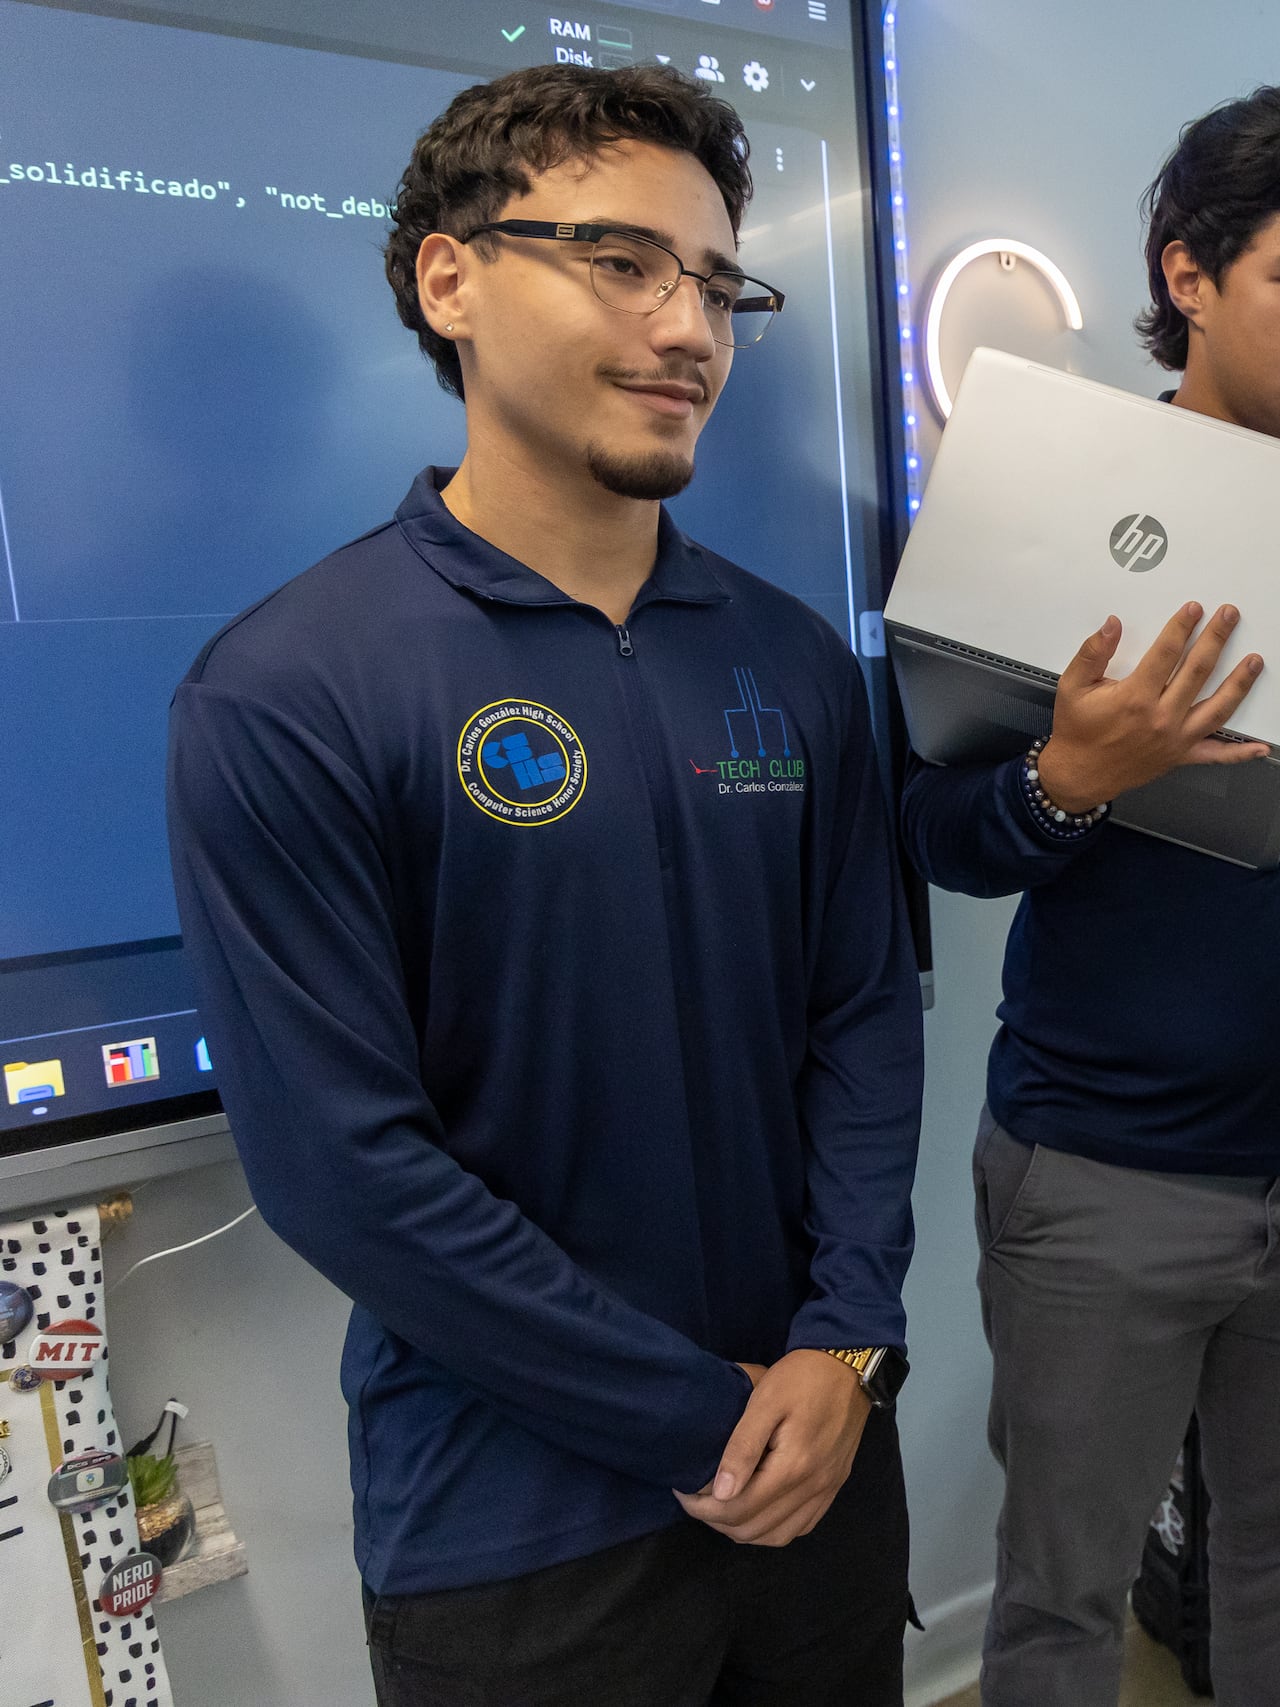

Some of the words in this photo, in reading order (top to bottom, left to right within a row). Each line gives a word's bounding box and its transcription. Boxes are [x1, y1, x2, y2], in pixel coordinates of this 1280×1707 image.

[549, 18, 591, 41] RAM
[555, 46, 594, 68] Disk
[1111, 513, 1165, 571] hp
[478, 707, 521, 728] González
[521, 706, 545, 720] High
[546, 715, 576, 742] School
[462, 727, 482, 756] Carlos
[461, 758, 472, 773] Dr.
[716, 760, 760, 779] TECH
[769, 759, 805, 778] CLUB
[468, 782, 513, 815] Computer
[514, 804, 553, 817] Science
[552, 784, 576, 808] Honor
[569, 749, 582, 785] Society
[718, 783, 733, 794] Dr.
[735, 782, 766, 793] Carlos
[767, 781, 804, 792] González
[36, 1342, 100, 1361] MIT
[112, 1560, 153, 1592] NERD
[113, 1580, 153, 1611] PRIDE
